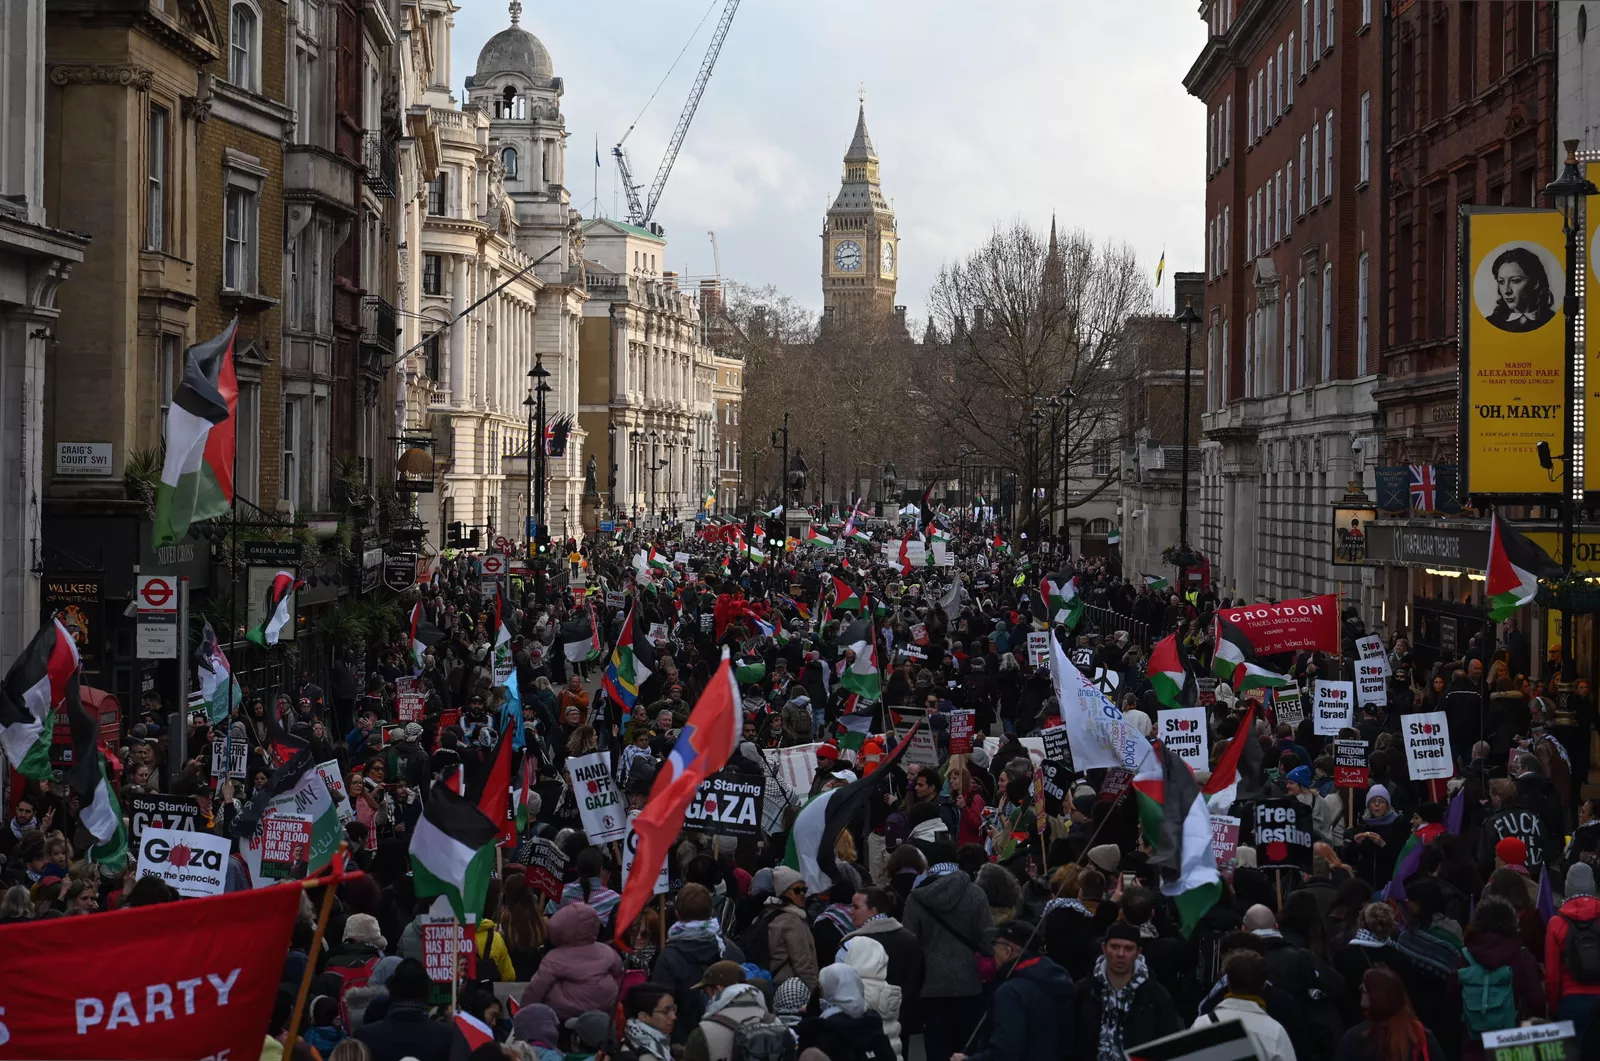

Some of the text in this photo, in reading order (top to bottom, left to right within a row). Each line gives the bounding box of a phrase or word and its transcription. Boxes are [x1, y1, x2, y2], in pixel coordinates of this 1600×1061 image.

[61, 446, 92, 454] CRAIG'S
[61, 455, 107, 464] COURT SW1
[502, 544, 511, 553] M
[1403, 534, 1434, 556] TRAFALGAR
[48, 584, 98, 594] WALKERS
[1230, 604, 1324, 622] CROYDON
[1248, 620, 1270, 628] TRADES
[906, 644, 921, 652] Free
[1362, 642, 1380, 651] Stop
[1364, 650, 1384, 659] Arming
[1360, 666, 1382, 675] Stop
[1320, 687, 1347, 700] Stop
[1362, 684, 1384, 693] Israel
[1275, 700, 1301, 714] FREE
[1318, 700, 1349, 710] Arming
[1320, 709, 1347, 719] Israel
[1166, 718, 1198, 733] Stop
[1410, 722, 1440, 735] Stop
[1164, 733, 1202, 745] Arming
[1410, 737, 1444, 747] Arming
[214, 741, 246, 756] CEEFIRE
[1337, 746, 1364, 755] FREEDOM
[1414, 747, 1444, 760] Israel
[1336, 757, 1367, 767] PALESTINE
[714, 779, 760, 796] Starving
[133, 799, 198, 816] Stop Starving
[685, 792, 757, 826] GAZA
[1256, 804, 1296, 824] Free
[133, 812, 196, 837] GAZA
[267, 821, 303, 832] STARMER
[1494, 812, 1540, 841] FUCK
[266, 830, 282, 840] HAS
[283, 832, 309, 843] BLOOD
[1217, 833, 1225, 841] TO
[1256, 824, 1312, 848] lestine
[265, 841, 292, 851] ON HIS
[1211, 841, 1234, 851] GAINST
[144, 838, 222, 871] Gza
[264, 850, 290, 860] HANDS
[535, 845, 564, 868] FREEDOM
[531, 856, 564, 881] PALESTINE
[142, 868, 162, 878] Stop
[179, 873, 220, 886] genocide
[425, 926, 464, 940] STARMR
[425, 940, 442, 954] HAS
[426, 954, 453, 967] ON HIS
[426, 967, 453, 980] HANDS
[75, 968, 242, 1035] PARTY
[1496, 1029, 1559, 1044] Socialist Worker
[1495, 1041, 1566, 1061] FROM THE
